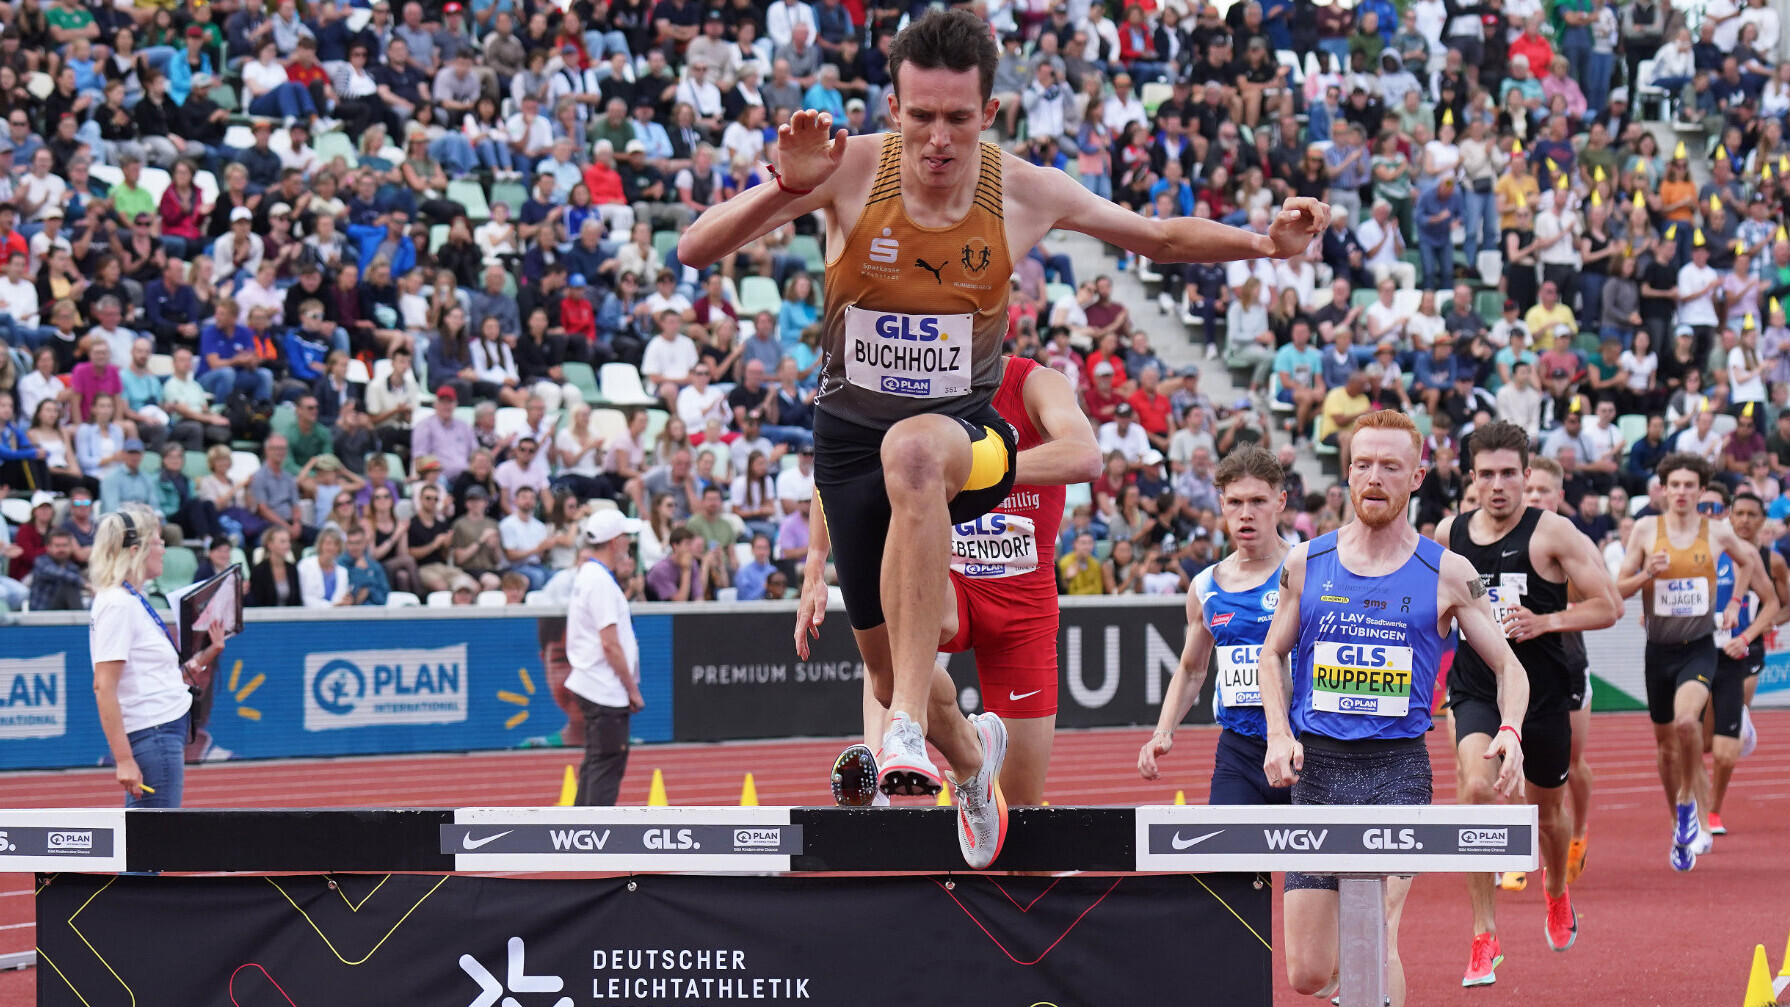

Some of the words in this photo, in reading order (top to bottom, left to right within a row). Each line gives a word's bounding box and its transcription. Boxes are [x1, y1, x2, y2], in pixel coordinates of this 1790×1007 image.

[875, 314, 949, 342] GLS.
[855, 339, 961, 373] BUCHHOLZ
[901, 380, 928, 390] PLAN
[1363, 599, 1388, 611] gmg
[1257, 614, 1275, 623] POLIZ
[1340, 612, 1366, 624] LAV
[1365, 617, 1408, 629] Stadtwerke
[1340, 624, 1406, 642] TÜBINGEN
[1336, 645, 1394, 668] GLS.
[692, 653, 787, 685] PREMIUM
[1225, 668, 1259, 687] LAU
[373, 663, 459, 696] PLAN
[1317, 666, 1408, 694] RUPPERT
[1354, 699, 1377, 708] PLAN
[66, 835, 90, 843] PLAN
[549, 828, 611, 851] WGV
[642, 828, 701, 851] GLS.
[753, 832, 778, 840] PLAN
[1263, 828, 1328, 851] WGV
[1362, 828, 1424, 851] GLS.
[1480, 832, 1505, 840] PLAN
[593, 950, 746, 970] DEUTSCHER
[593, 978, 810, 999] LEICHTATHLETIK
